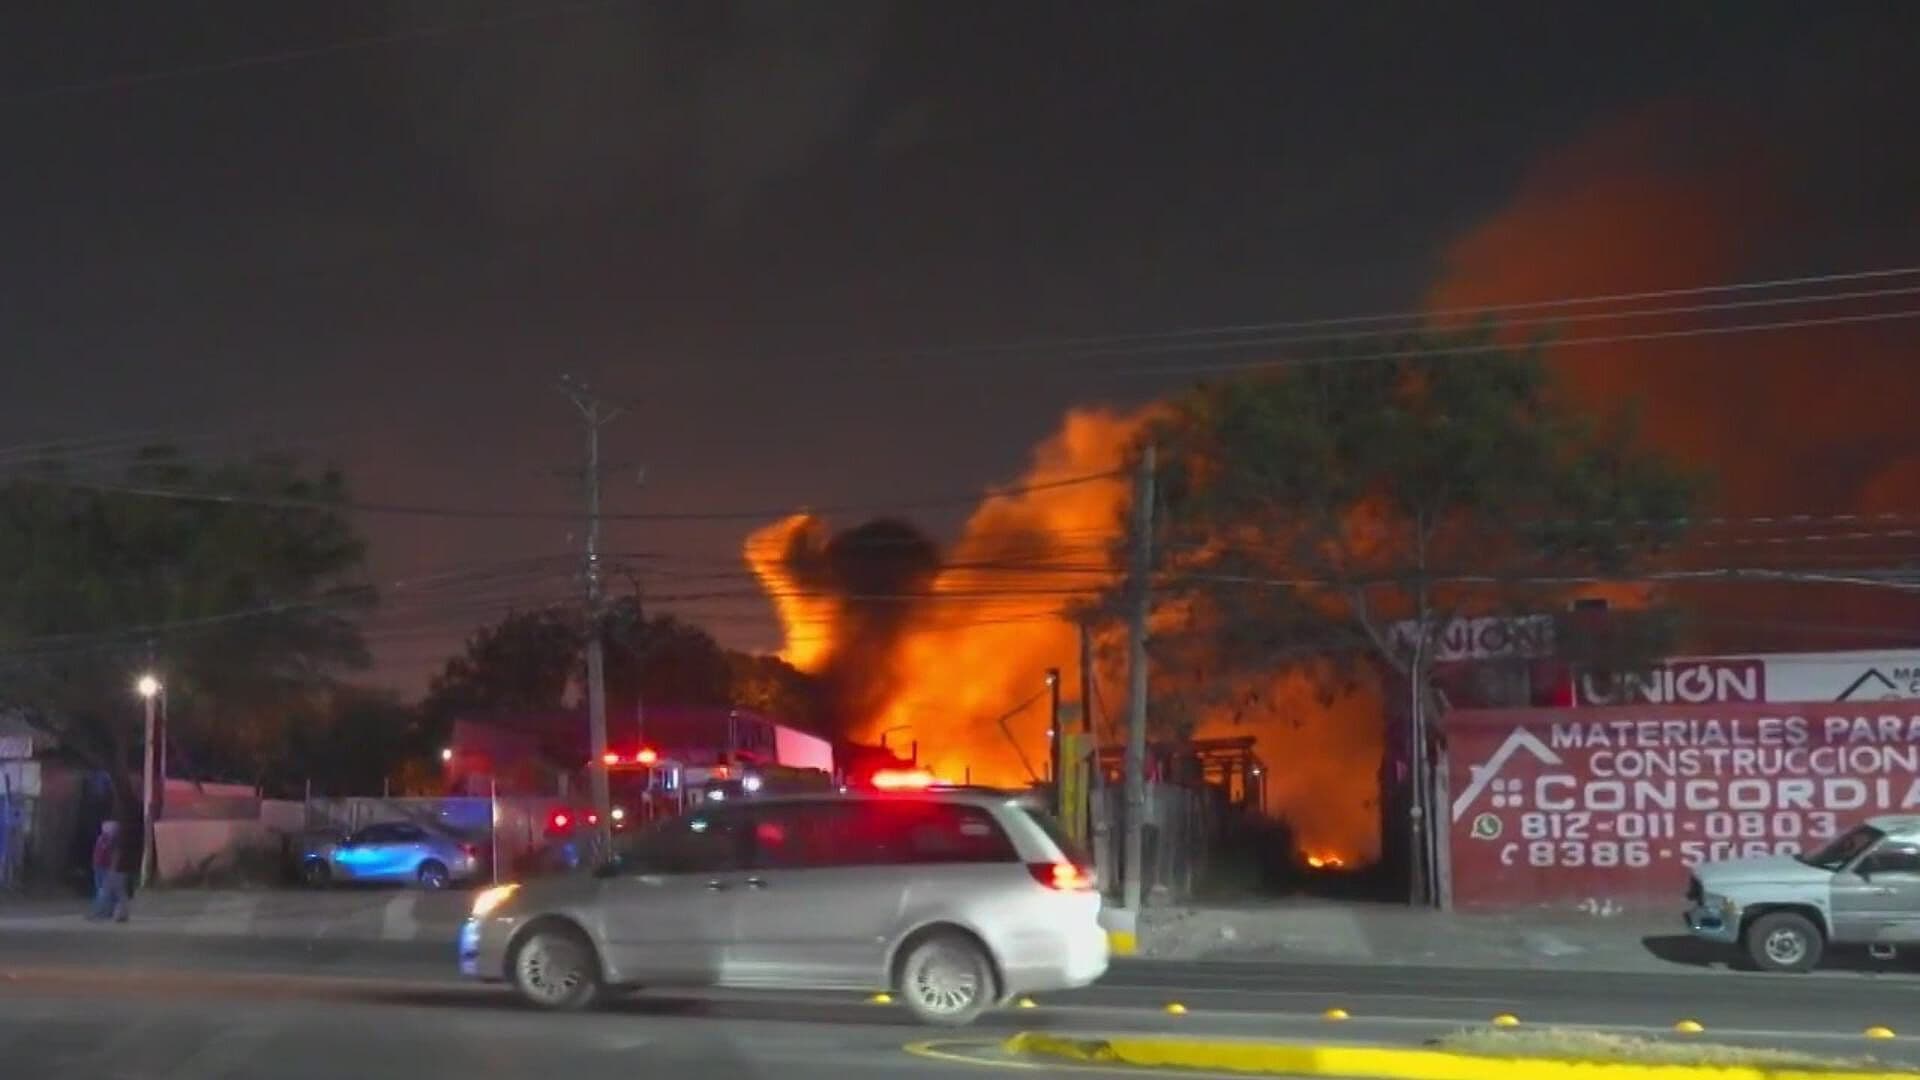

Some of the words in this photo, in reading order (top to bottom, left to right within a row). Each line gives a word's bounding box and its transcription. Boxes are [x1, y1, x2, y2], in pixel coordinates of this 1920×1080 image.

[1551, 716, 1809, 748] MATERIALES
[1824, 715, 1920, 744] PARA
[1590, 745, 1919, 777] CONSTRUCCION
